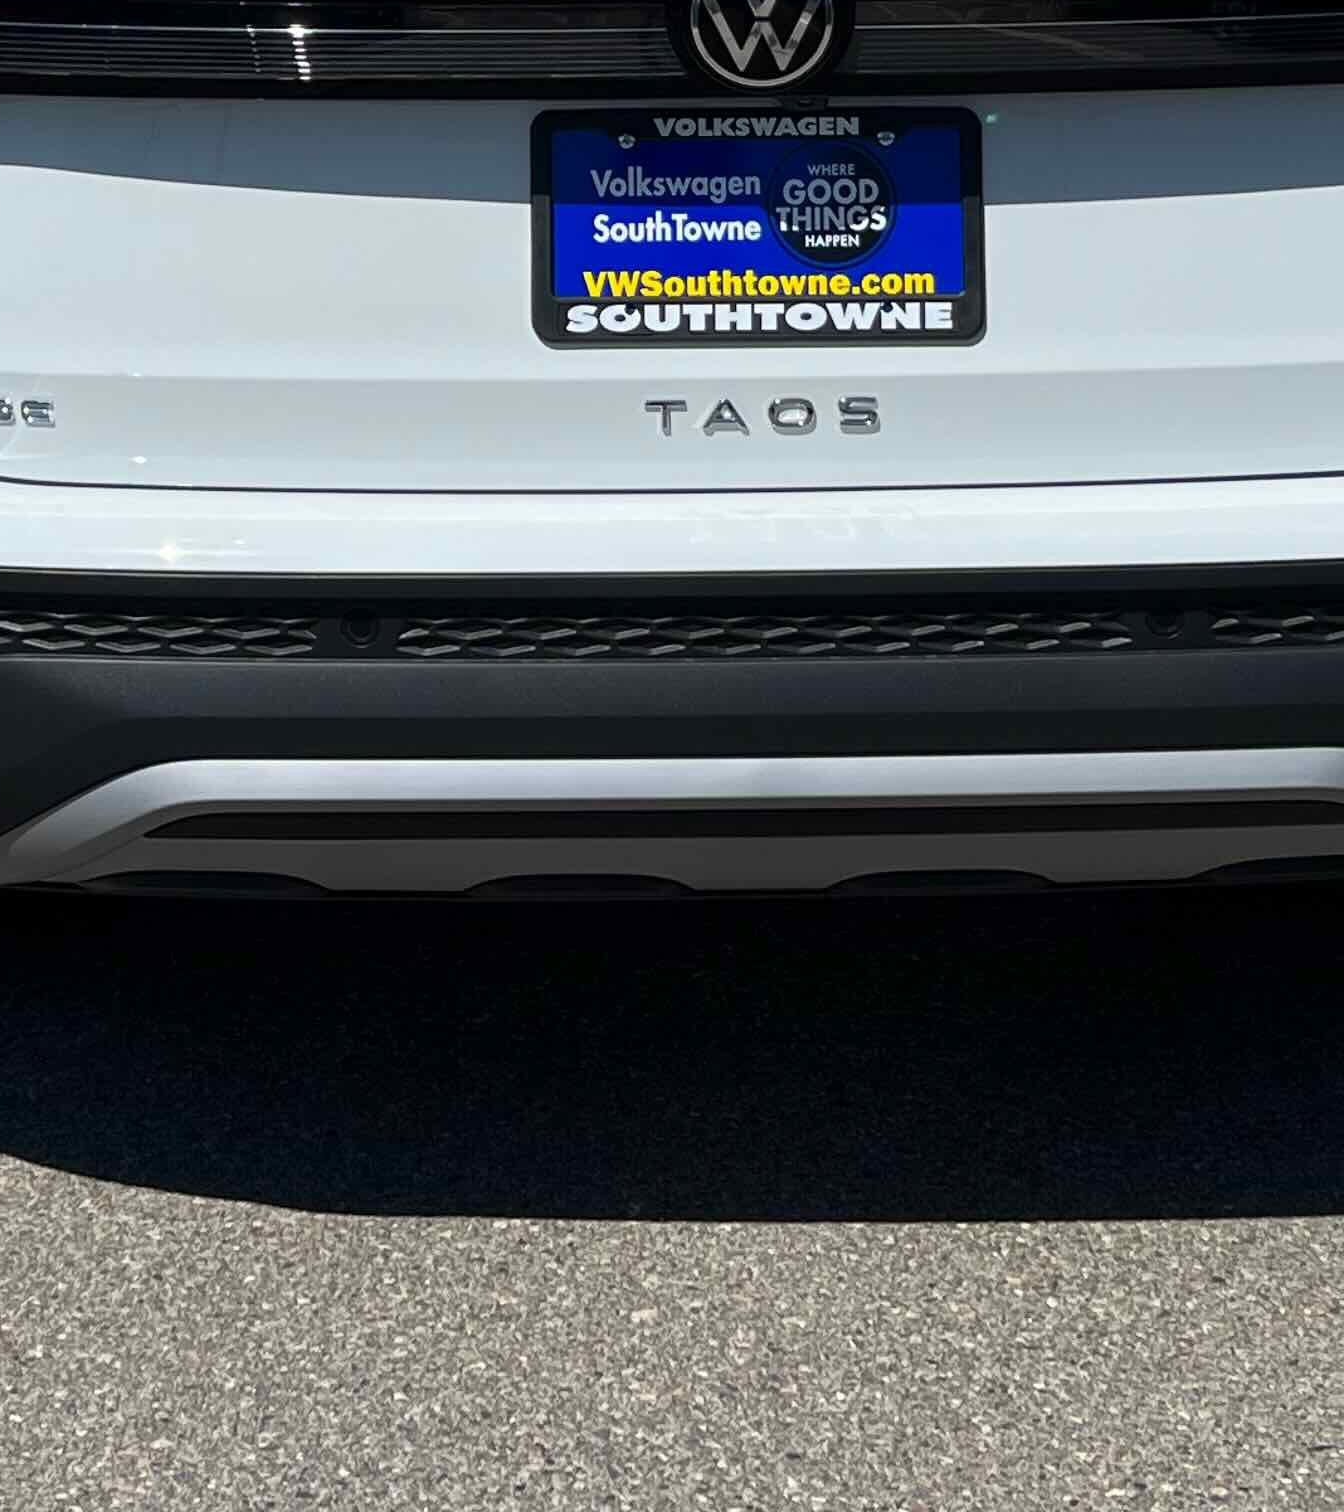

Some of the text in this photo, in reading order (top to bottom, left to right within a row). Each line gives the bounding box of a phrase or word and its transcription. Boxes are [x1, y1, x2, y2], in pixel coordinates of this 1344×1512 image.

[654, 116, 861, 138] VOLKSWAGEN
[807, 163, 856, 176] WHERE
[589, 165, 762, 205] Volkswagen
[782, 178, 880, 205] GOOD
[592, 210, 762, 243] SouthTowne
[775, 204, 887, 232] THINGS
[804, 233, 861, 248] HAPPEN
[583, 270, 936, 298] VWSouthtowne.com
[566, 302, 953, 332] SOUTHTOWNE
[643, 396, 882, 437] TAOS
